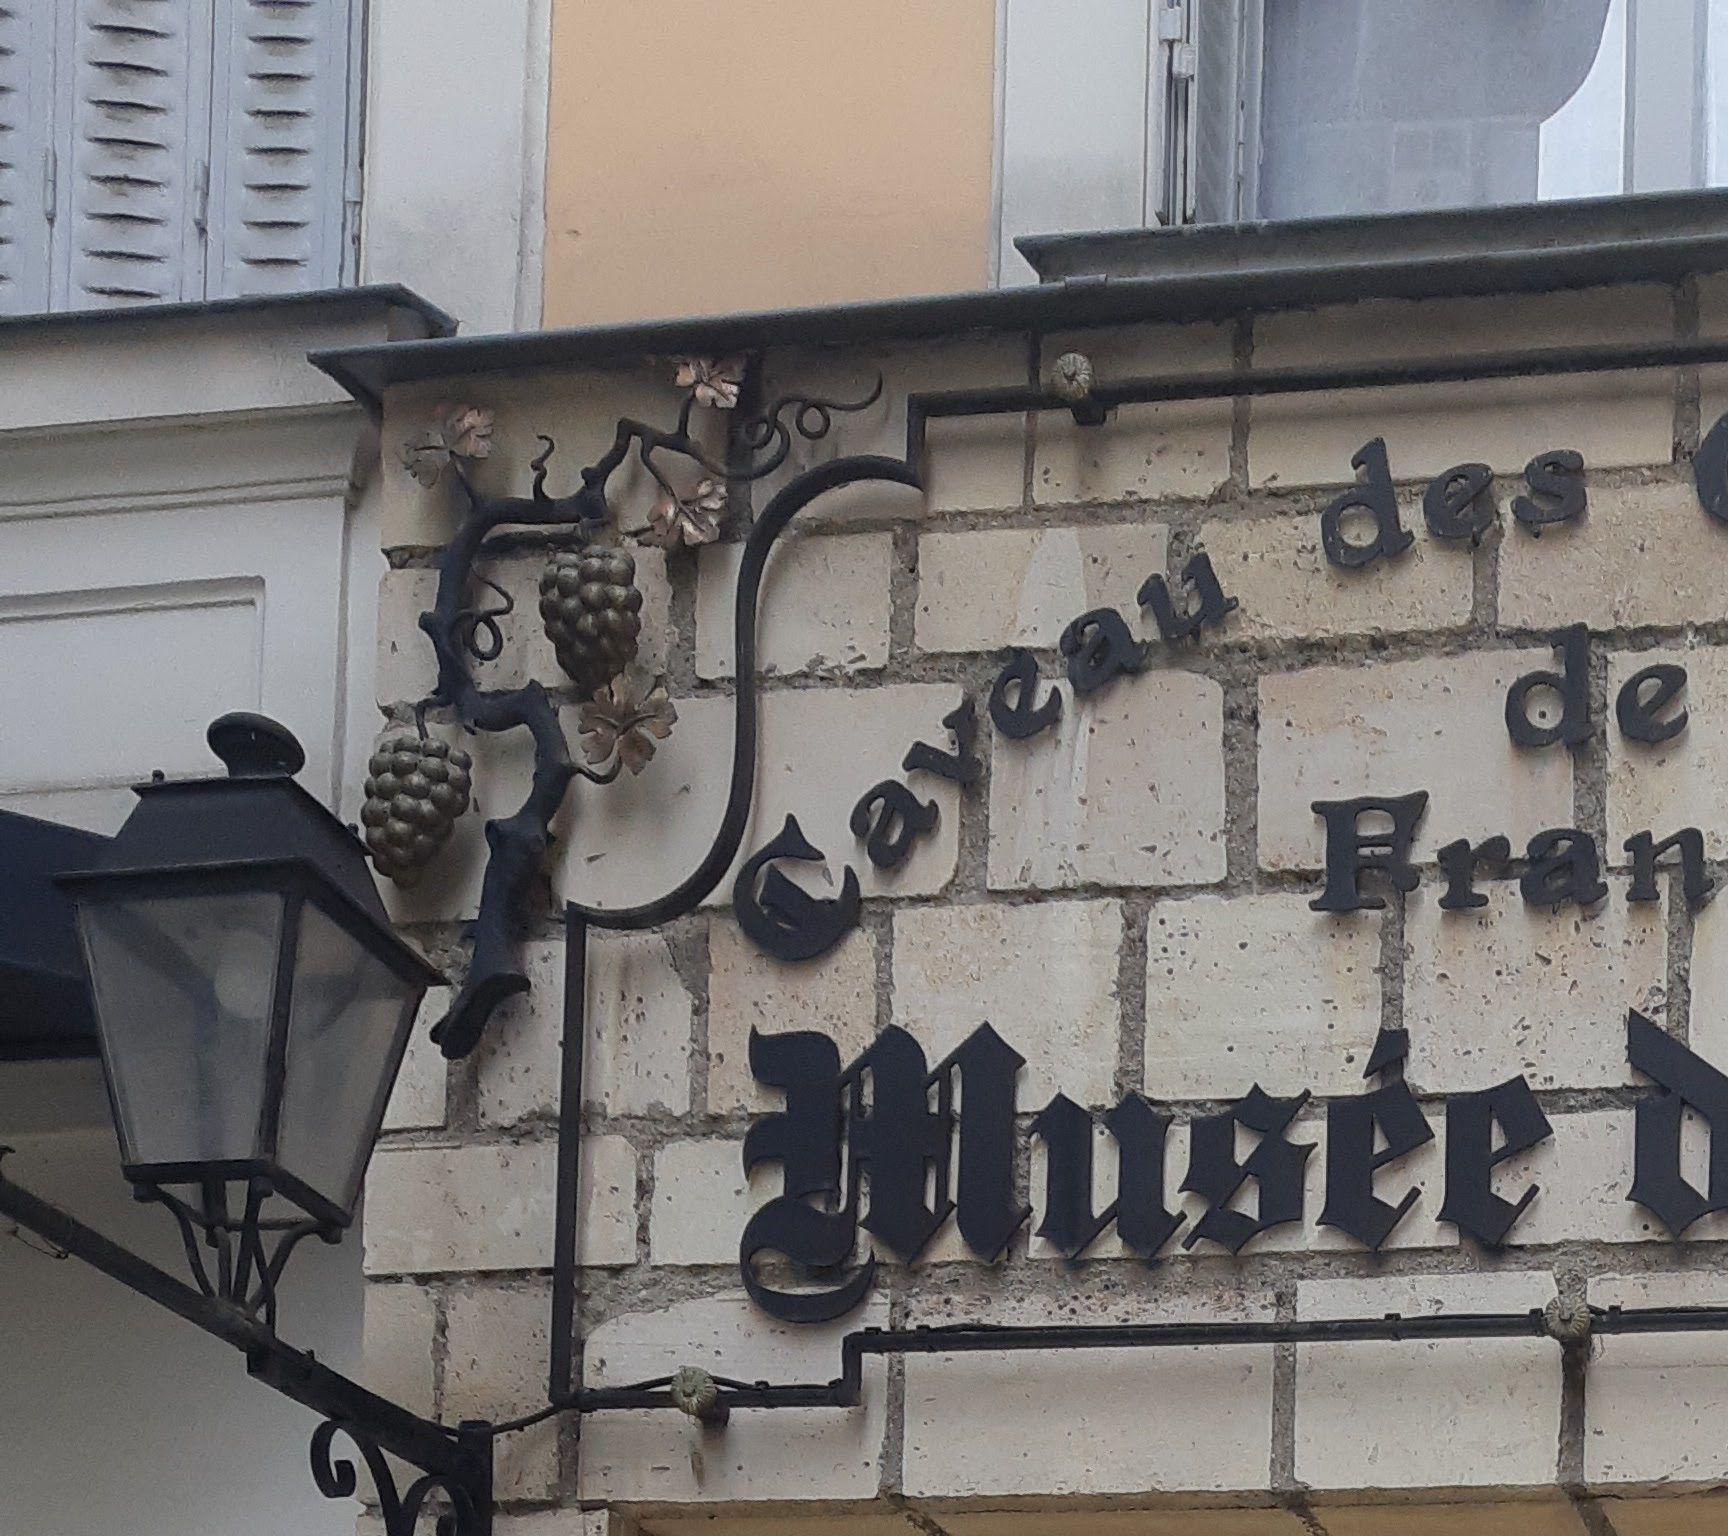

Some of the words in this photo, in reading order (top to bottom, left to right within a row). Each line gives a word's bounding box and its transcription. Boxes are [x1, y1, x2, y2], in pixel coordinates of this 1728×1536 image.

[733, 545, 1242, 962] Caveau
[1322, 436, 1588, 572] des
[1506, 624, 1690, 750] de
[740, 1020, 1556, 1324] Musée
